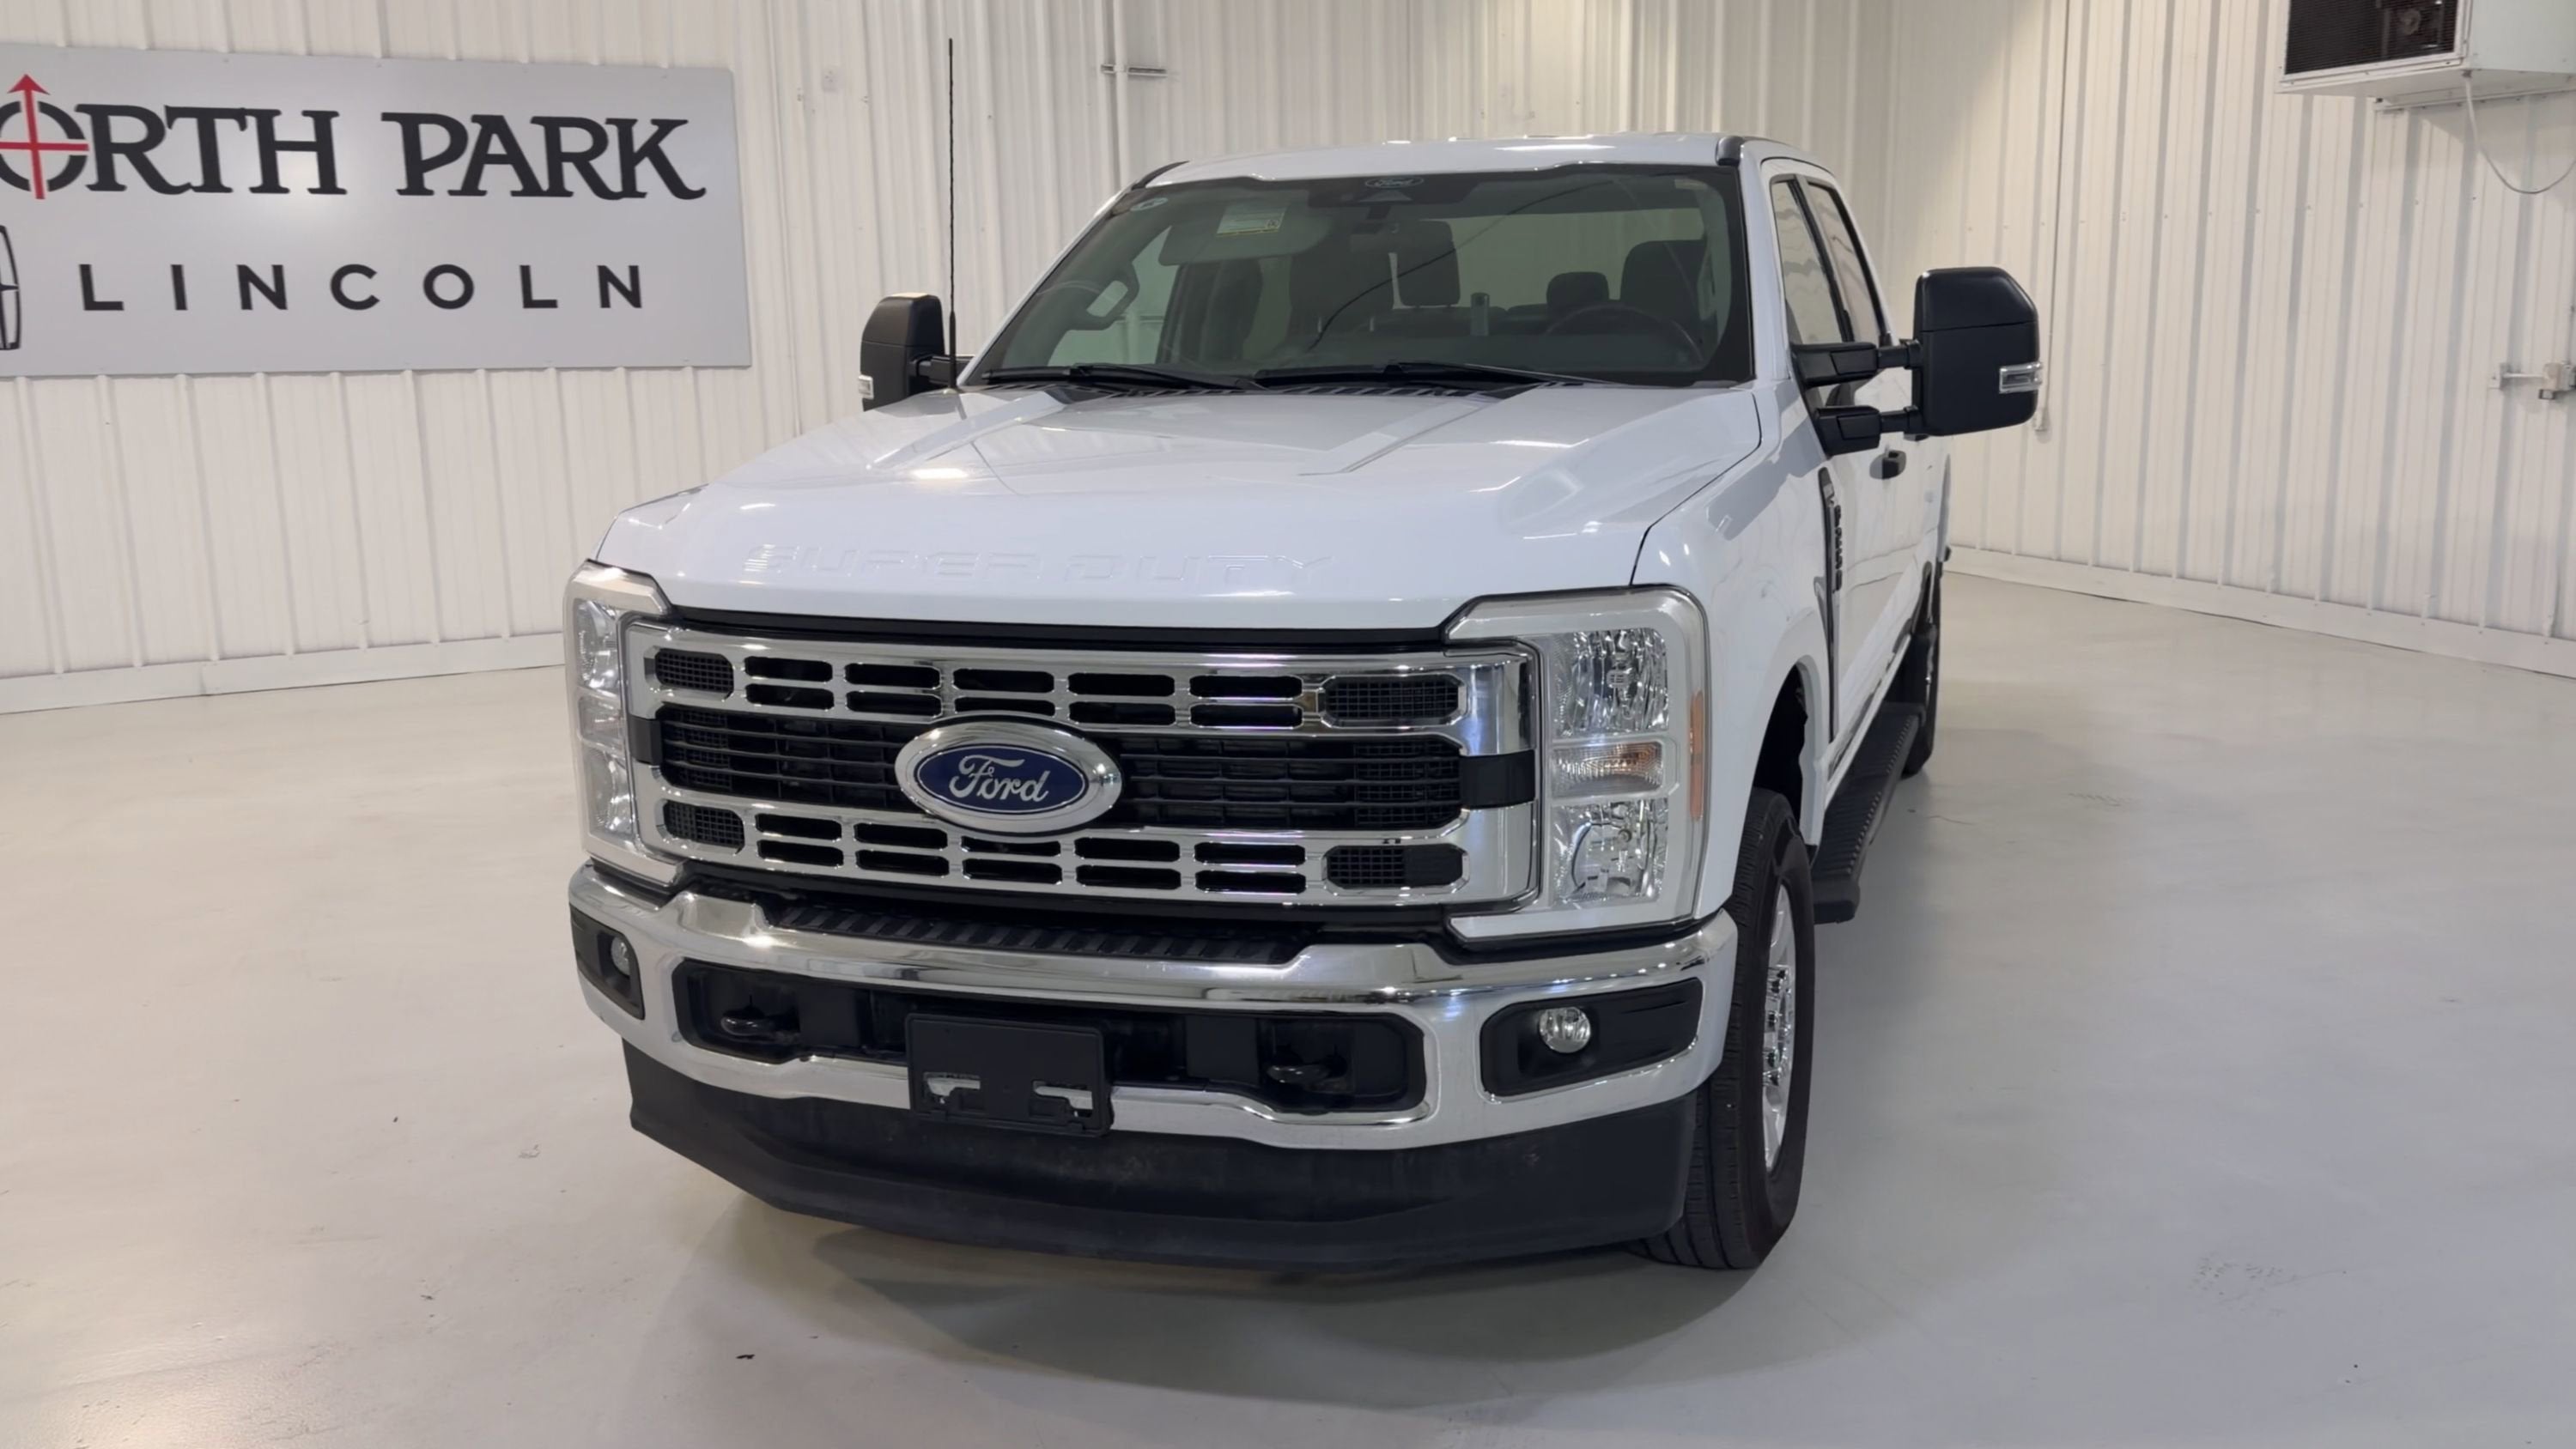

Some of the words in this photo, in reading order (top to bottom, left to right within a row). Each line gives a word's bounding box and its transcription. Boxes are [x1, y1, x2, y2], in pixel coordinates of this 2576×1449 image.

[380, 111, 708, 200] PARK
[78, 263, 643, 312] LINCOLN
[742, 543, 1044, 584] SUPER
[1065, 552, 1334, 585] DUTY
[949, 754, 1051, 803] Ford
